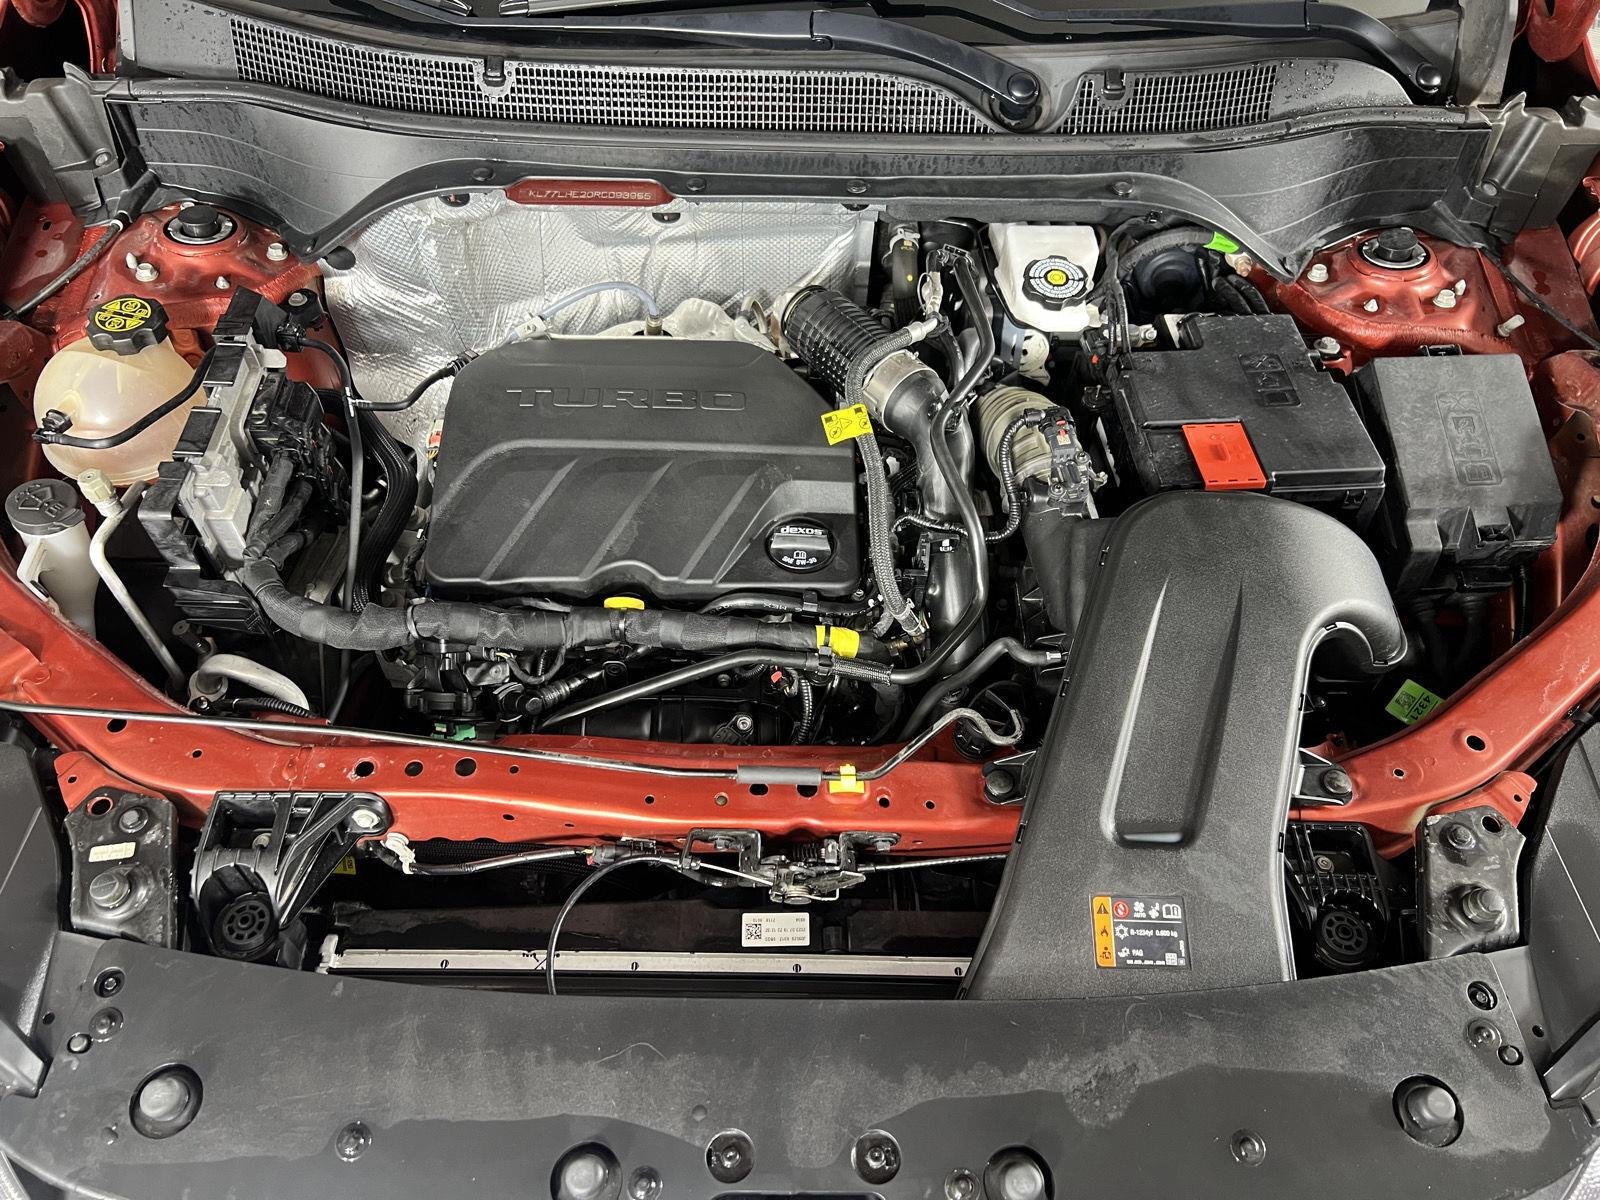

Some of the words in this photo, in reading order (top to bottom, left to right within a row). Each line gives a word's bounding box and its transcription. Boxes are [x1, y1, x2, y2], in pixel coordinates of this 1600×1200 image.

[506, 387, 746, 410] TURBO
[780, 525, 824, 535] dexos
[1410, 695, 1431, 720] 4321
